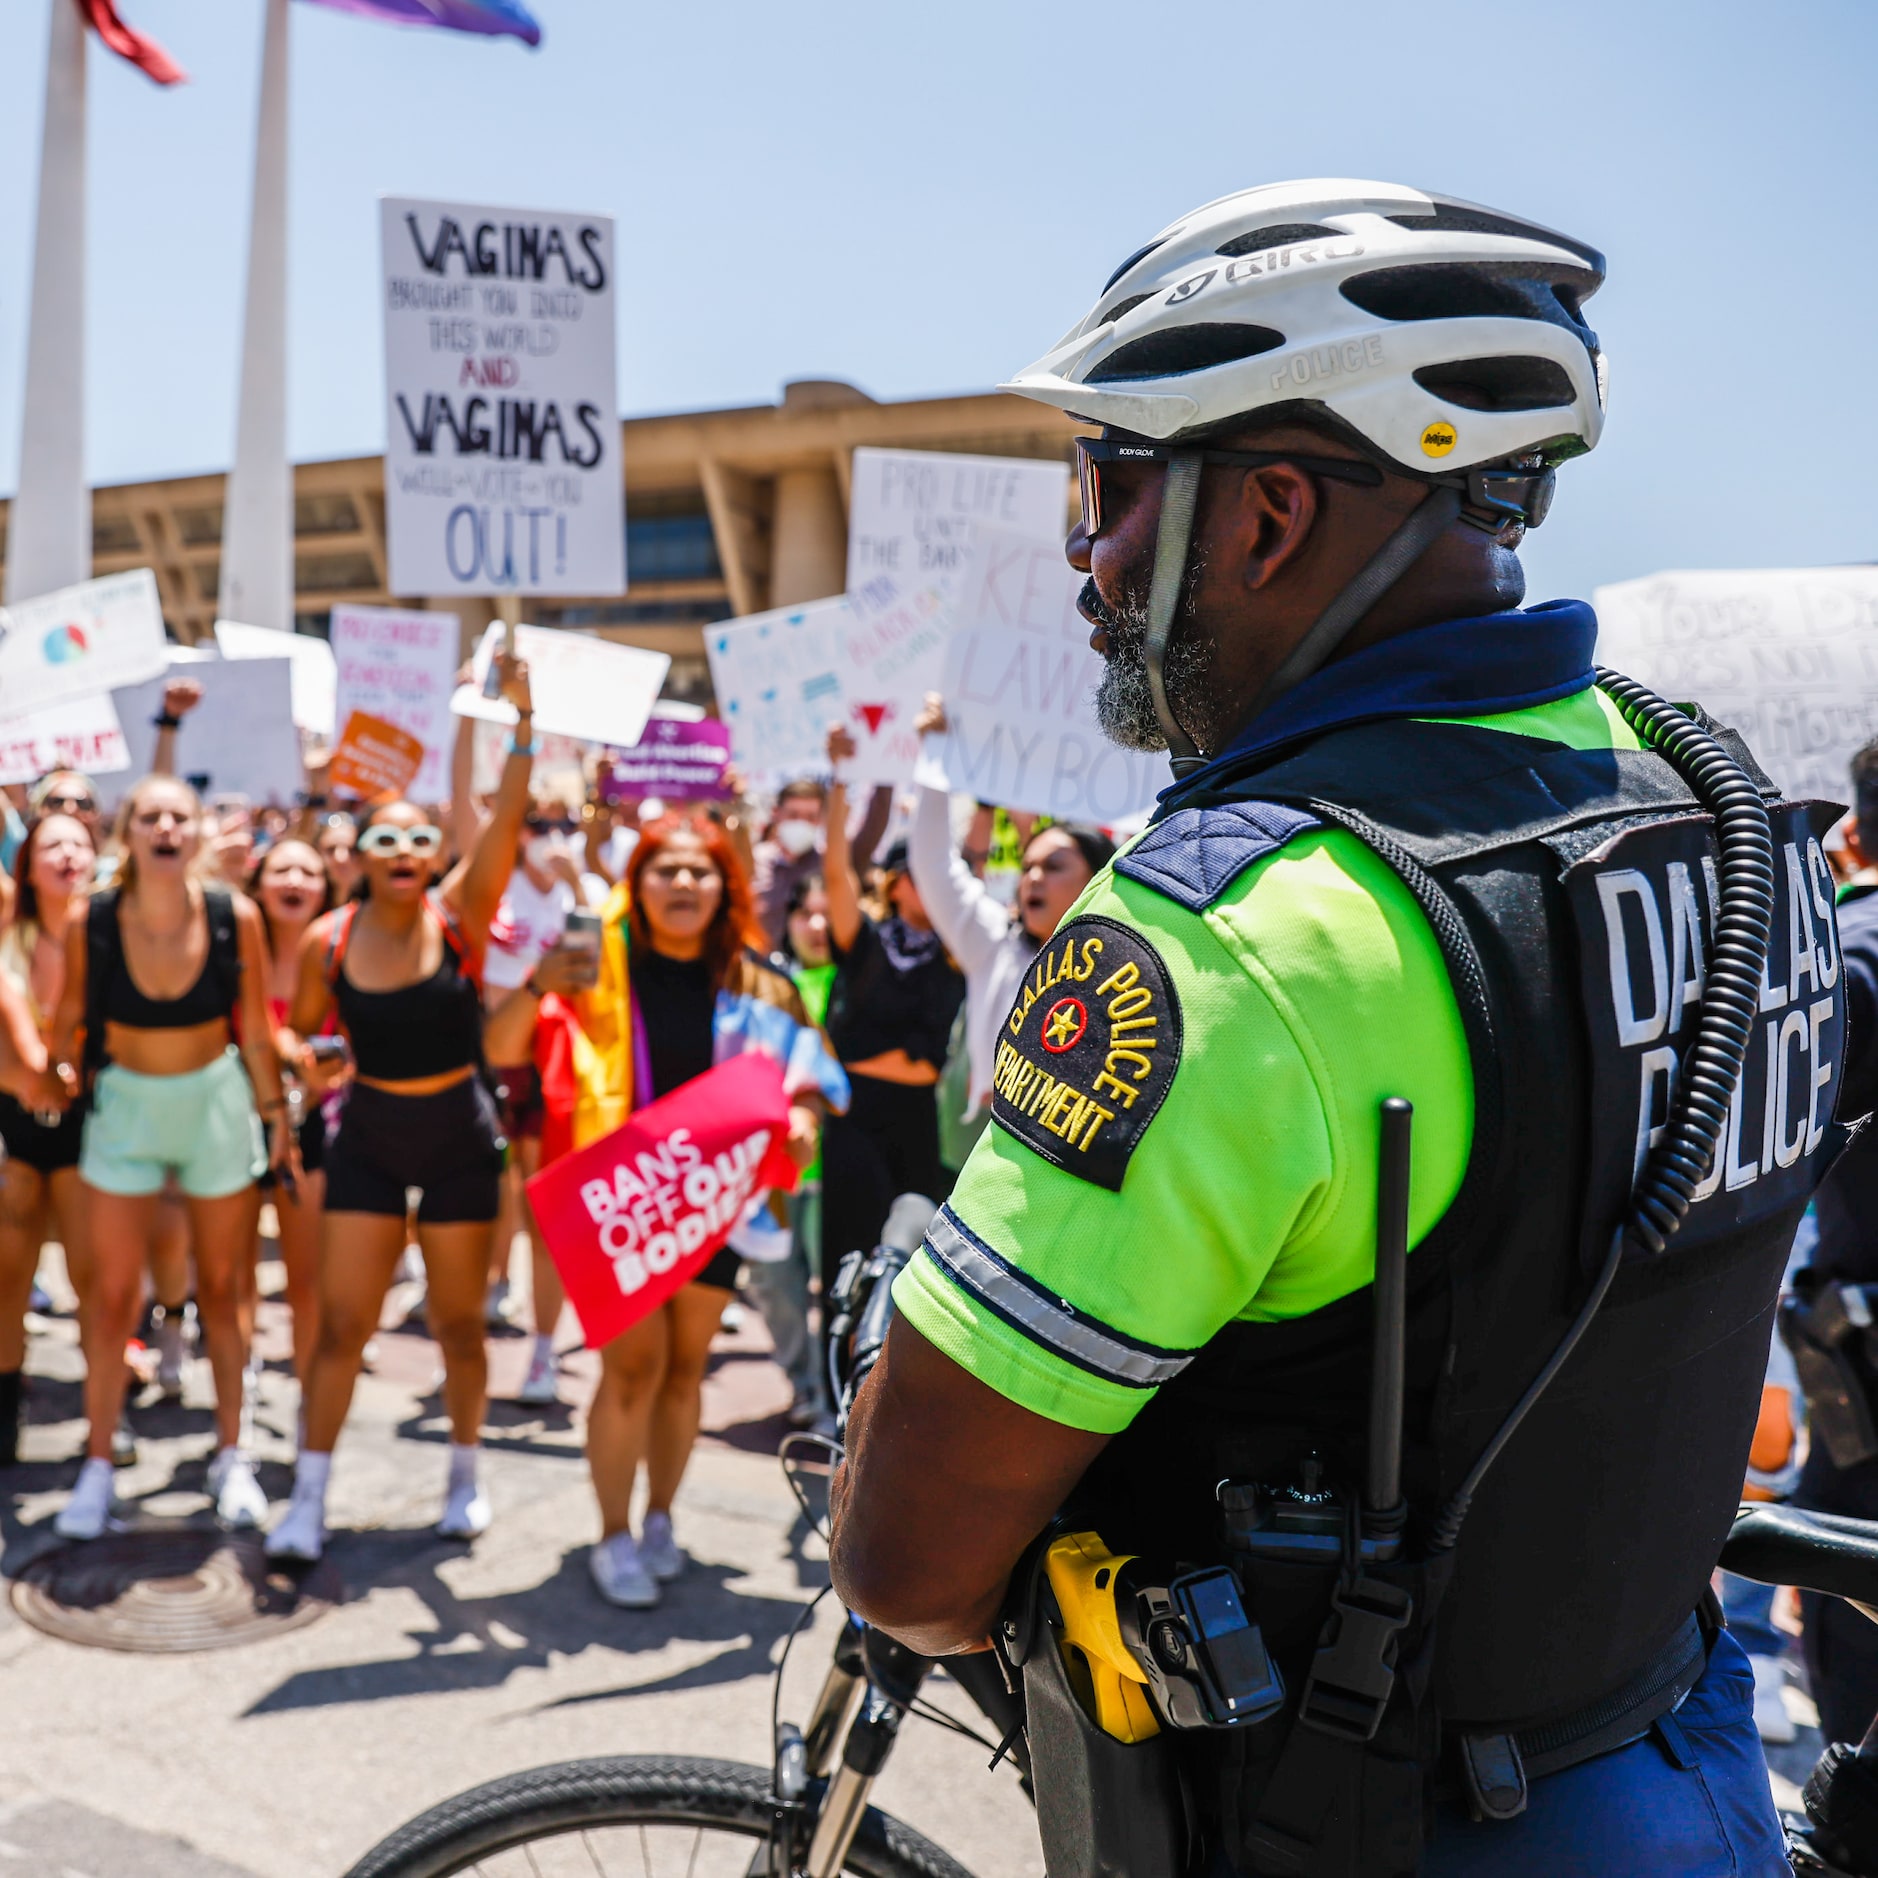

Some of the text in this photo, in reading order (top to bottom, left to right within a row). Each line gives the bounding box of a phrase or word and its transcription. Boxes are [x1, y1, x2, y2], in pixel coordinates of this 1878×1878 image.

[405, 212, 606, 292] VAGINAS
[428, 316, 560, 356] THIS WORLD
[479, 286, 519, 317] YOU
[458, 355, 520, 389] AND
[396, 392, 603, 469] VAGINAS
[1119, 447, 1155, 457] BODY GLOVE
[880, 460, 1024, 521] PRO LIFE
[445, 504, 567, 587] OUT!
[858, 534, 902, 570] THE
[943, 711, 1044, 799] MY
[1009, 937, 1158, 1109] DALLAS POLICE
[1630, 996, 1834, 1202] PLICE
[580, 1127, 702, 1225] BANS
[598, 1182, 682, 1259] OFF
